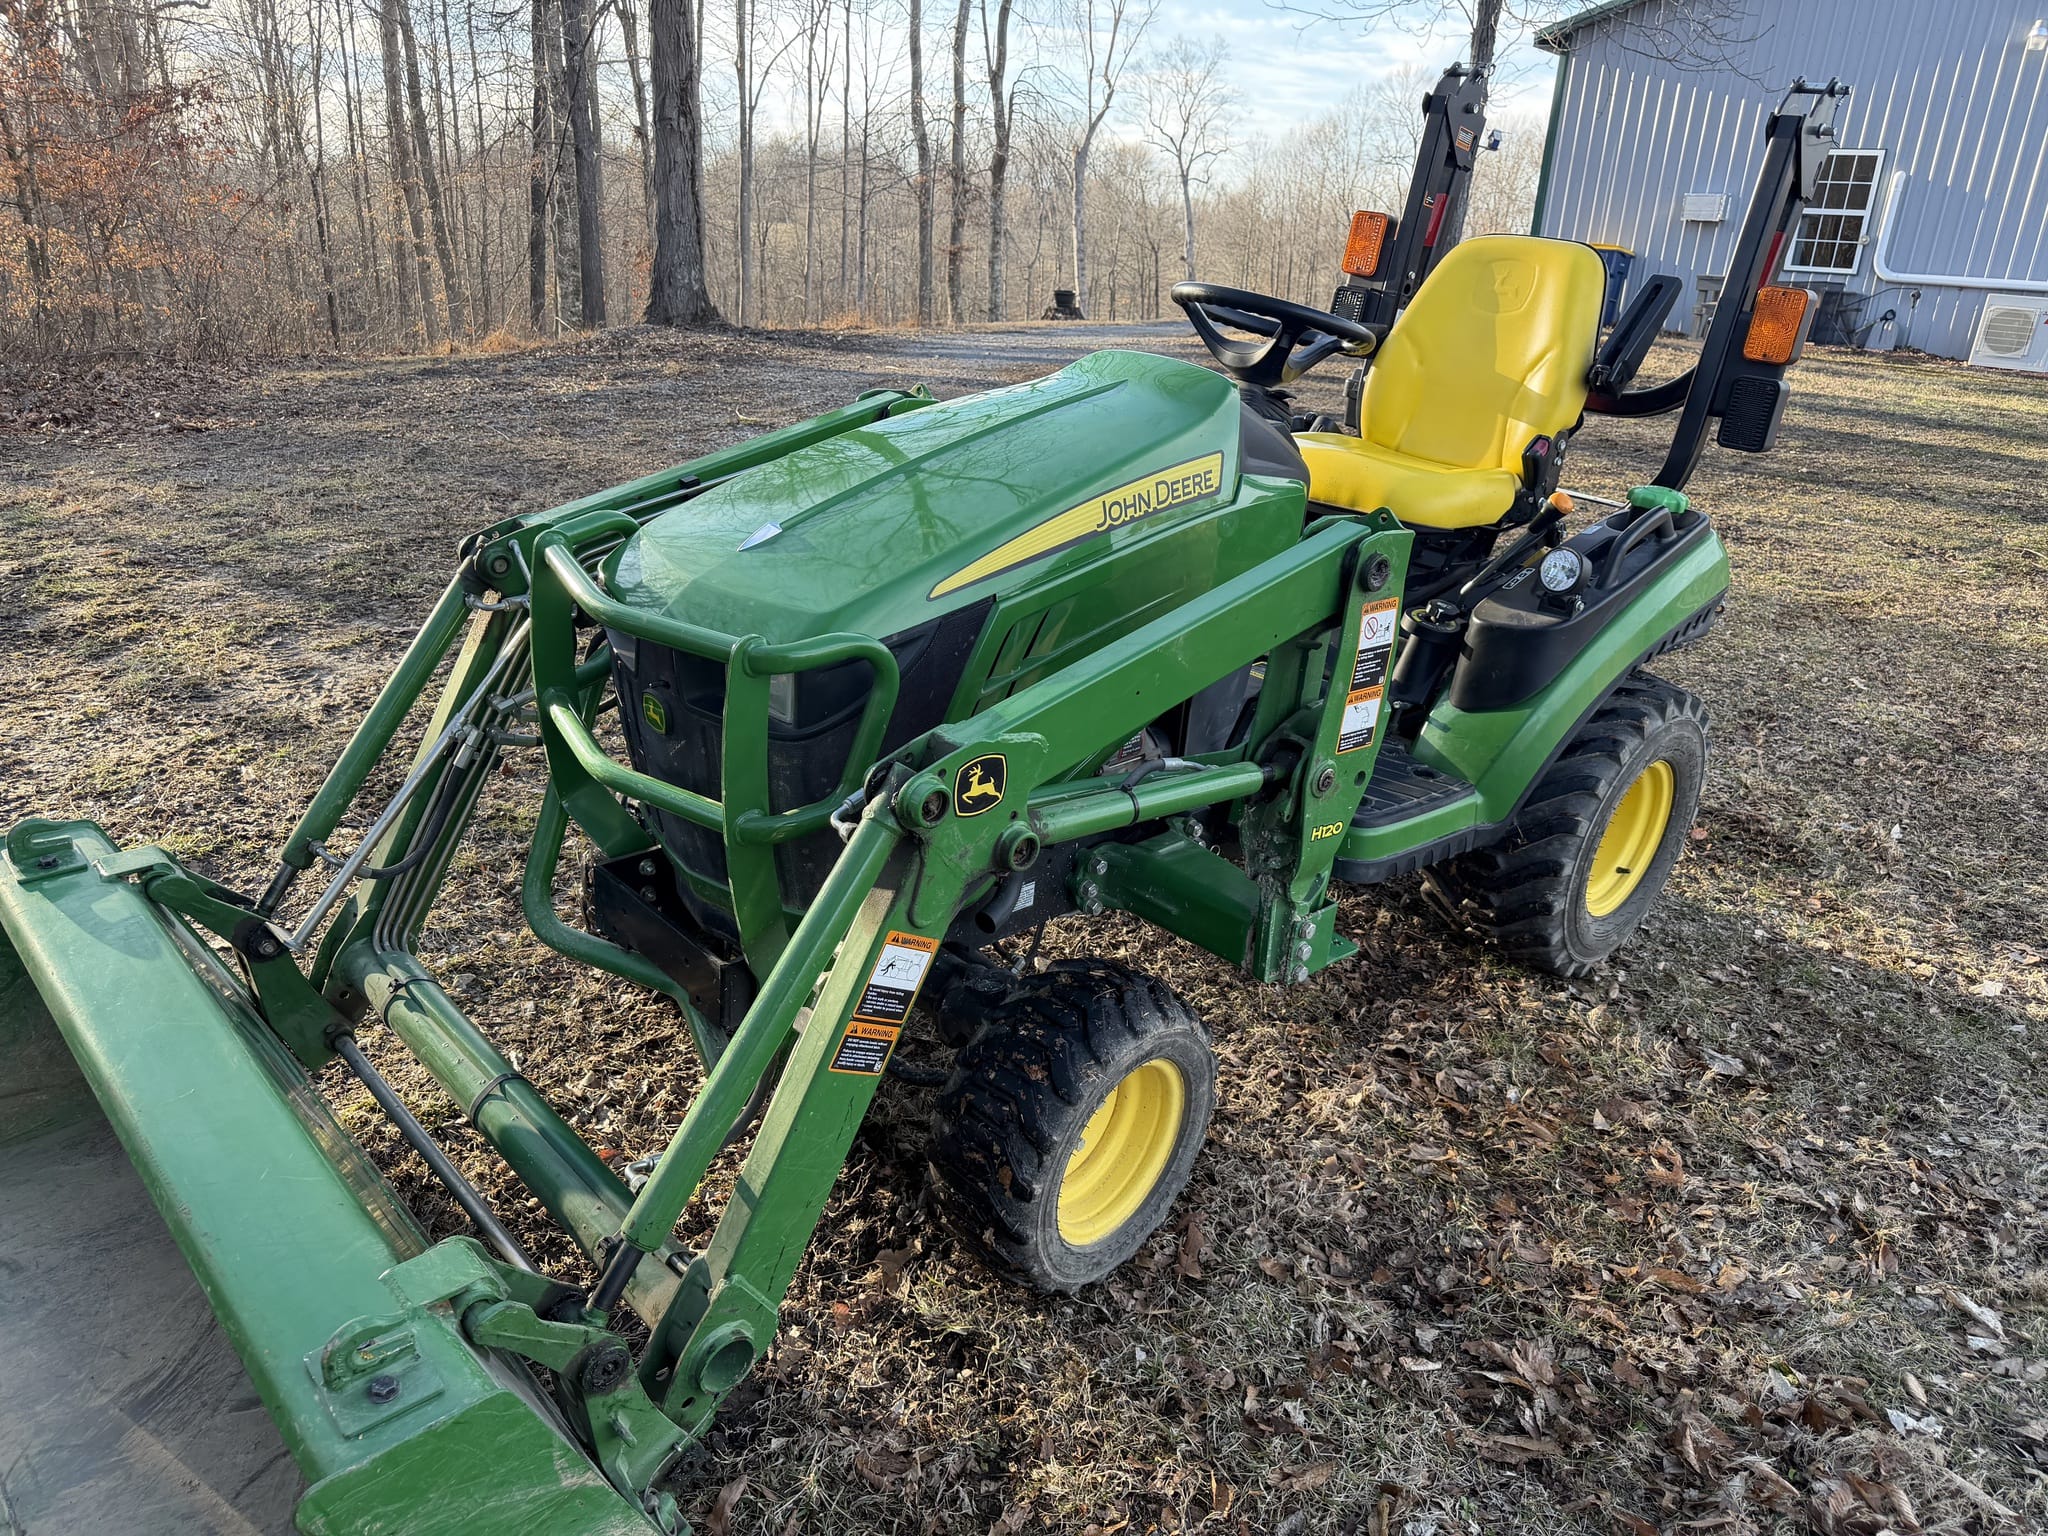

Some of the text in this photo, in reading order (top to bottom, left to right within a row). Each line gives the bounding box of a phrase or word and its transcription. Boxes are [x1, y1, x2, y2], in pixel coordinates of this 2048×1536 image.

[1097, 469, 1214, 529] JOHN DEERE
[1369, 599, 1397, 613] WARNING
[1354, 690, 1382, 702] WARNING
[1310, 821, 1344, 842] H120
[901, 937, 932, 949] WARNING
[860, 1027, 893, 1038] WARNING
